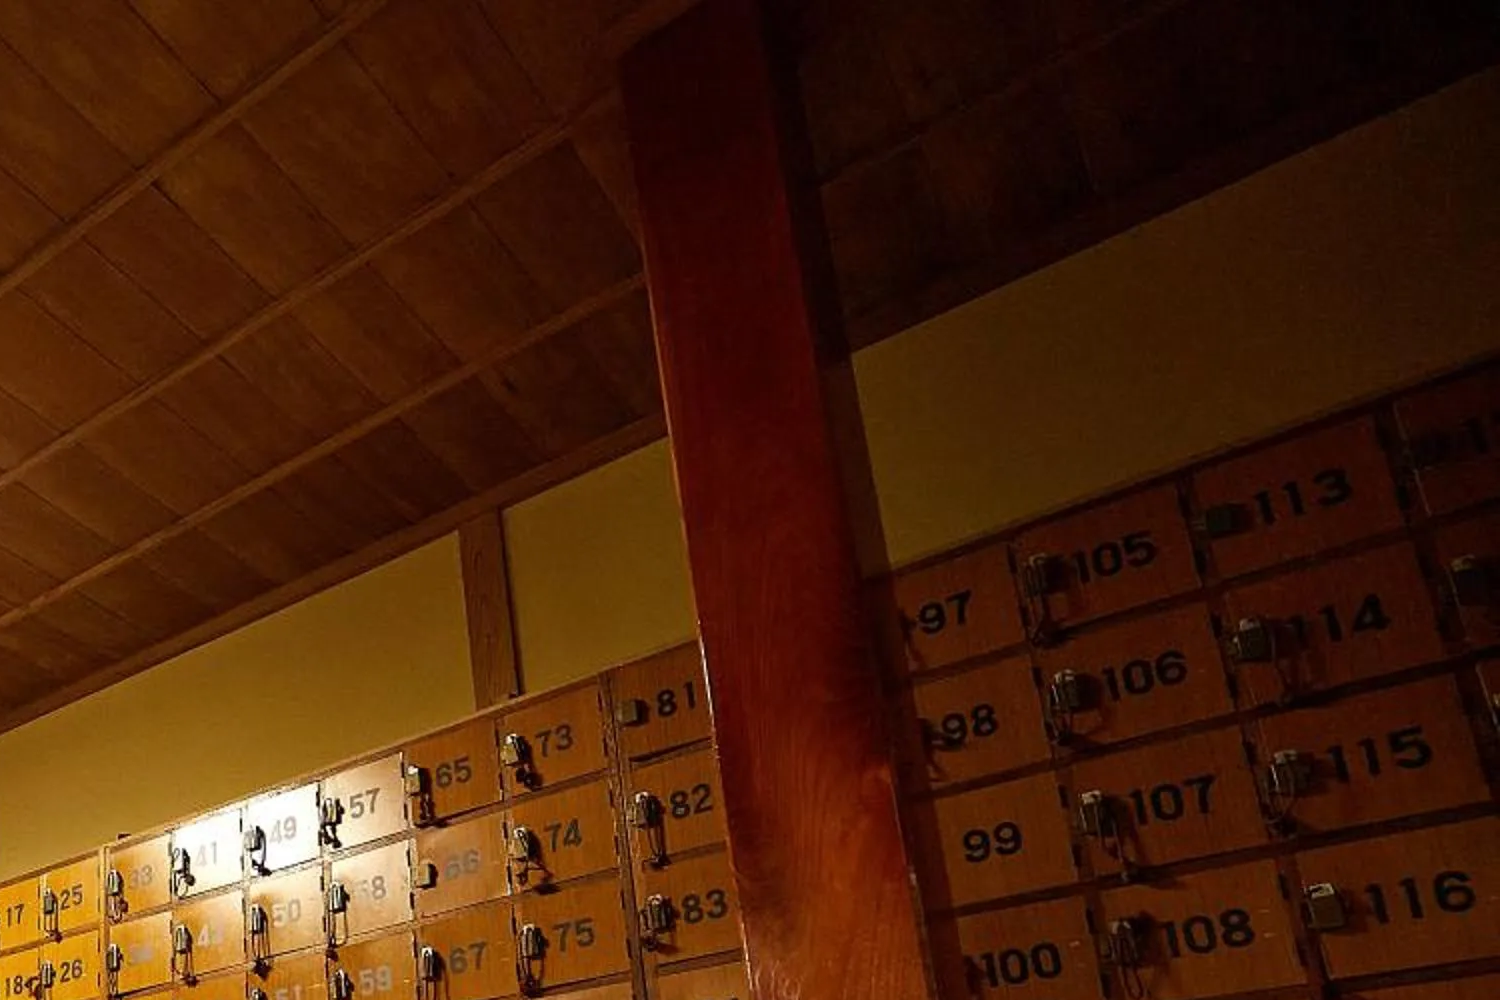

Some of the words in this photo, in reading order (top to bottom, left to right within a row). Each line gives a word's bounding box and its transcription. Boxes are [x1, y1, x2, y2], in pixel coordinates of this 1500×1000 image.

[1255, 469, 1351, 524] 113
[1074, 530, 1156, 584] 105
[920, 590, 970, 634] 97
[1102, 649, 1188, 701] 106
[658, 681, 695, 717] 81
[536, 724, 573, 758] 73
[942, 704, 998, 748] 98
[1329, 725, 1432, 782] 115
[435, 756, 472, 788] 65
[350, 788, 381, 819] 57
[669, 783, 713, 819] 82
[1130, 775, 1216, 826] 107
[269, 816, 297, 844] 49
[544, 819, 582, 852] 74
[962, 821, 1023, 863] 99
[195, 841, 218, 866] 41
[444, 849, 481, 877] 66
[60, 884, 83, 909] 25
[273, 899, 301, 928] 50
[682, 888, 728, 924] 83
[1366, 870, 1475, 924] 116
[6, 904, 25, 925] 17
[198, 922, 225, 947] 4
[552, 917, 595, 952] 75
[1164, 909, 1255, 958] 108
[59, 959, 83, 981] 26
[450, 941, 488, 973] 67
[981, 942, 1061, 987] 100
[5, 975, 23, 995] 18
